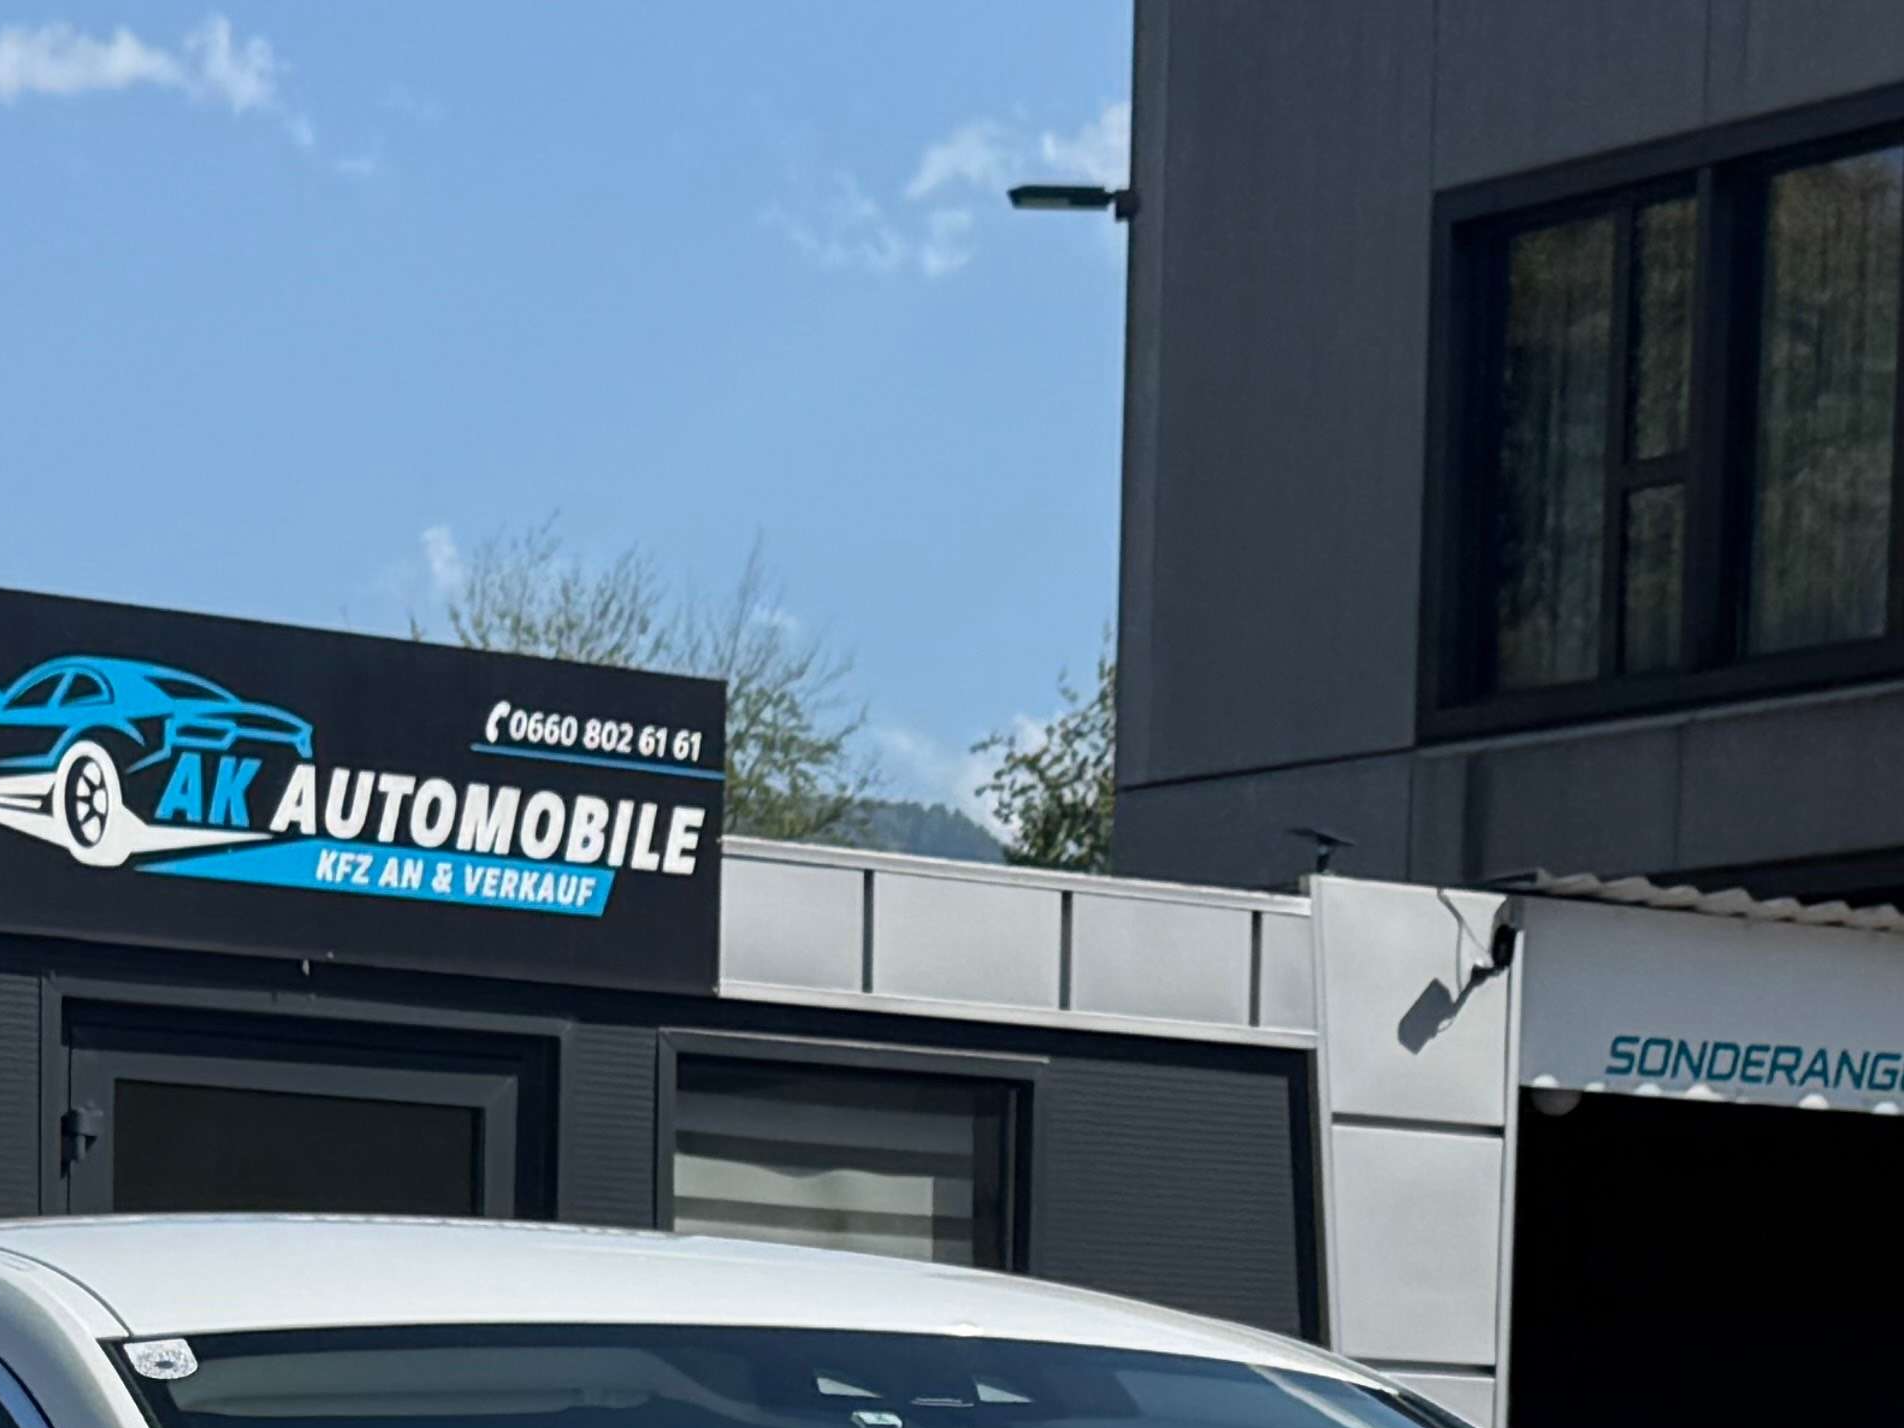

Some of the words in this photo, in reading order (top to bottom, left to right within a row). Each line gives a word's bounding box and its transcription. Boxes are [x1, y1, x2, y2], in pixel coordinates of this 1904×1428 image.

[509, 709, 578, 747] 0660
[583, 718, 634, 753] 802
[638, 725, 668, 758] 61
[672, 729, 703, 762] 61
[154, 752, 262, 829] AK
[270, 763, 706, 876] AUTOMOBILE
[315, 848, 371, 886] KFZ
[377, 855, 424, 891] AN
[430, 859, 453, 892] &
[464, 863, 598, 908] VERKAUF
